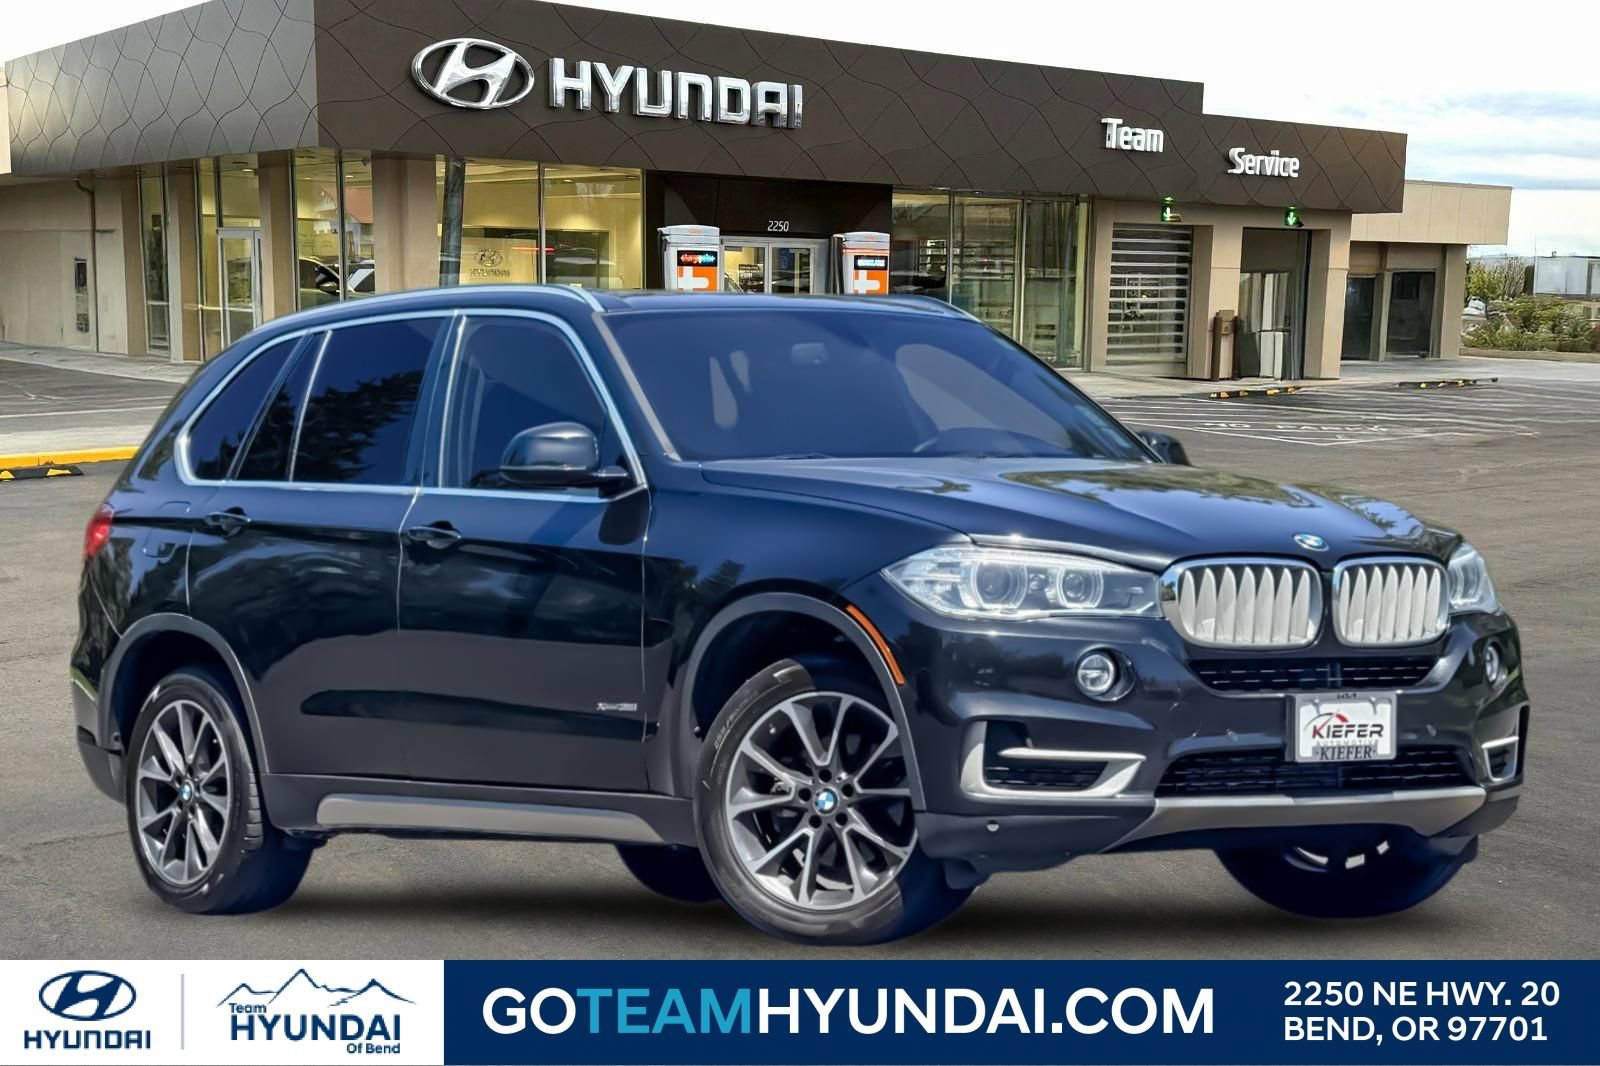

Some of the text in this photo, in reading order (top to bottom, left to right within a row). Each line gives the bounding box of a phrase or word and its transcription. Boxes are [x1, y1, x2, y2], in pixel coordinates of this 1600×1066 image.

[548, 56, 803, 129] HYUNDAI
[1101, 117, 1164, 153] Team
[1227, 147, 1300, 178] Service
[767, 220, 790, 232] 2250
[1312, 724, 1385, 739] KIEFER
[1319, 746, 1374, 761] KIEFER
